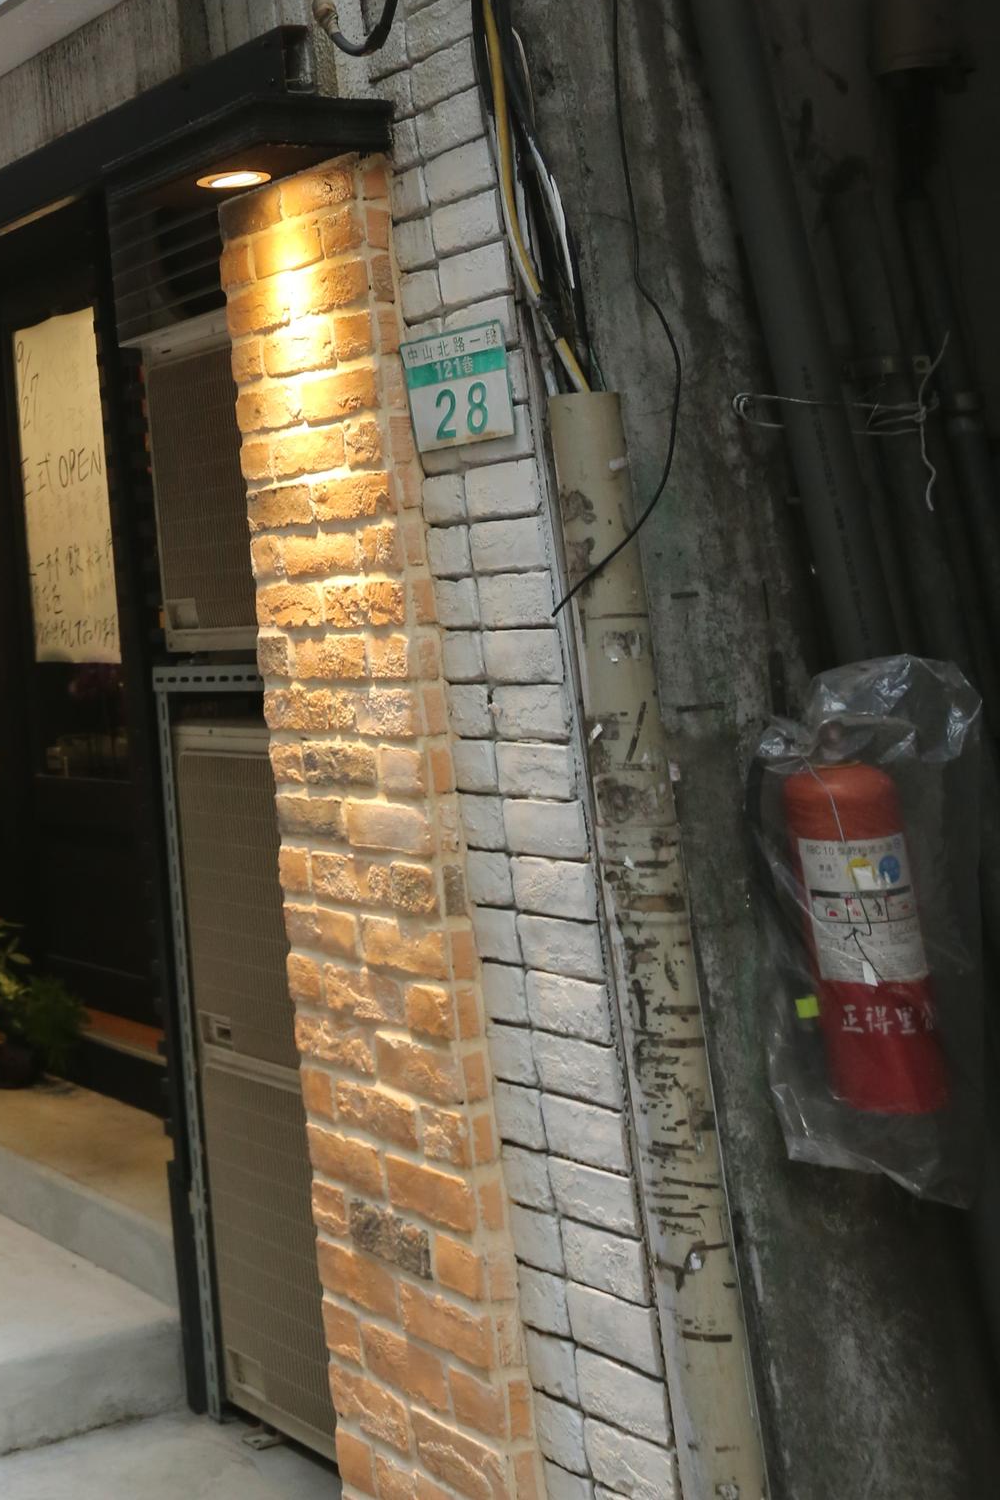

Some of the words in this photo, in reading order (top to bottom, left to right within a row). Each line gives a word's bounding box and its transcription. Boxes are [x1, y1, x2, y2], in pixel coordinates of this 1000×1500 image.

[407, 324, 498, 364] 中山北路一段
[434, 355, 474, 381] 121巷
[435, 381, 489, 440] 28
